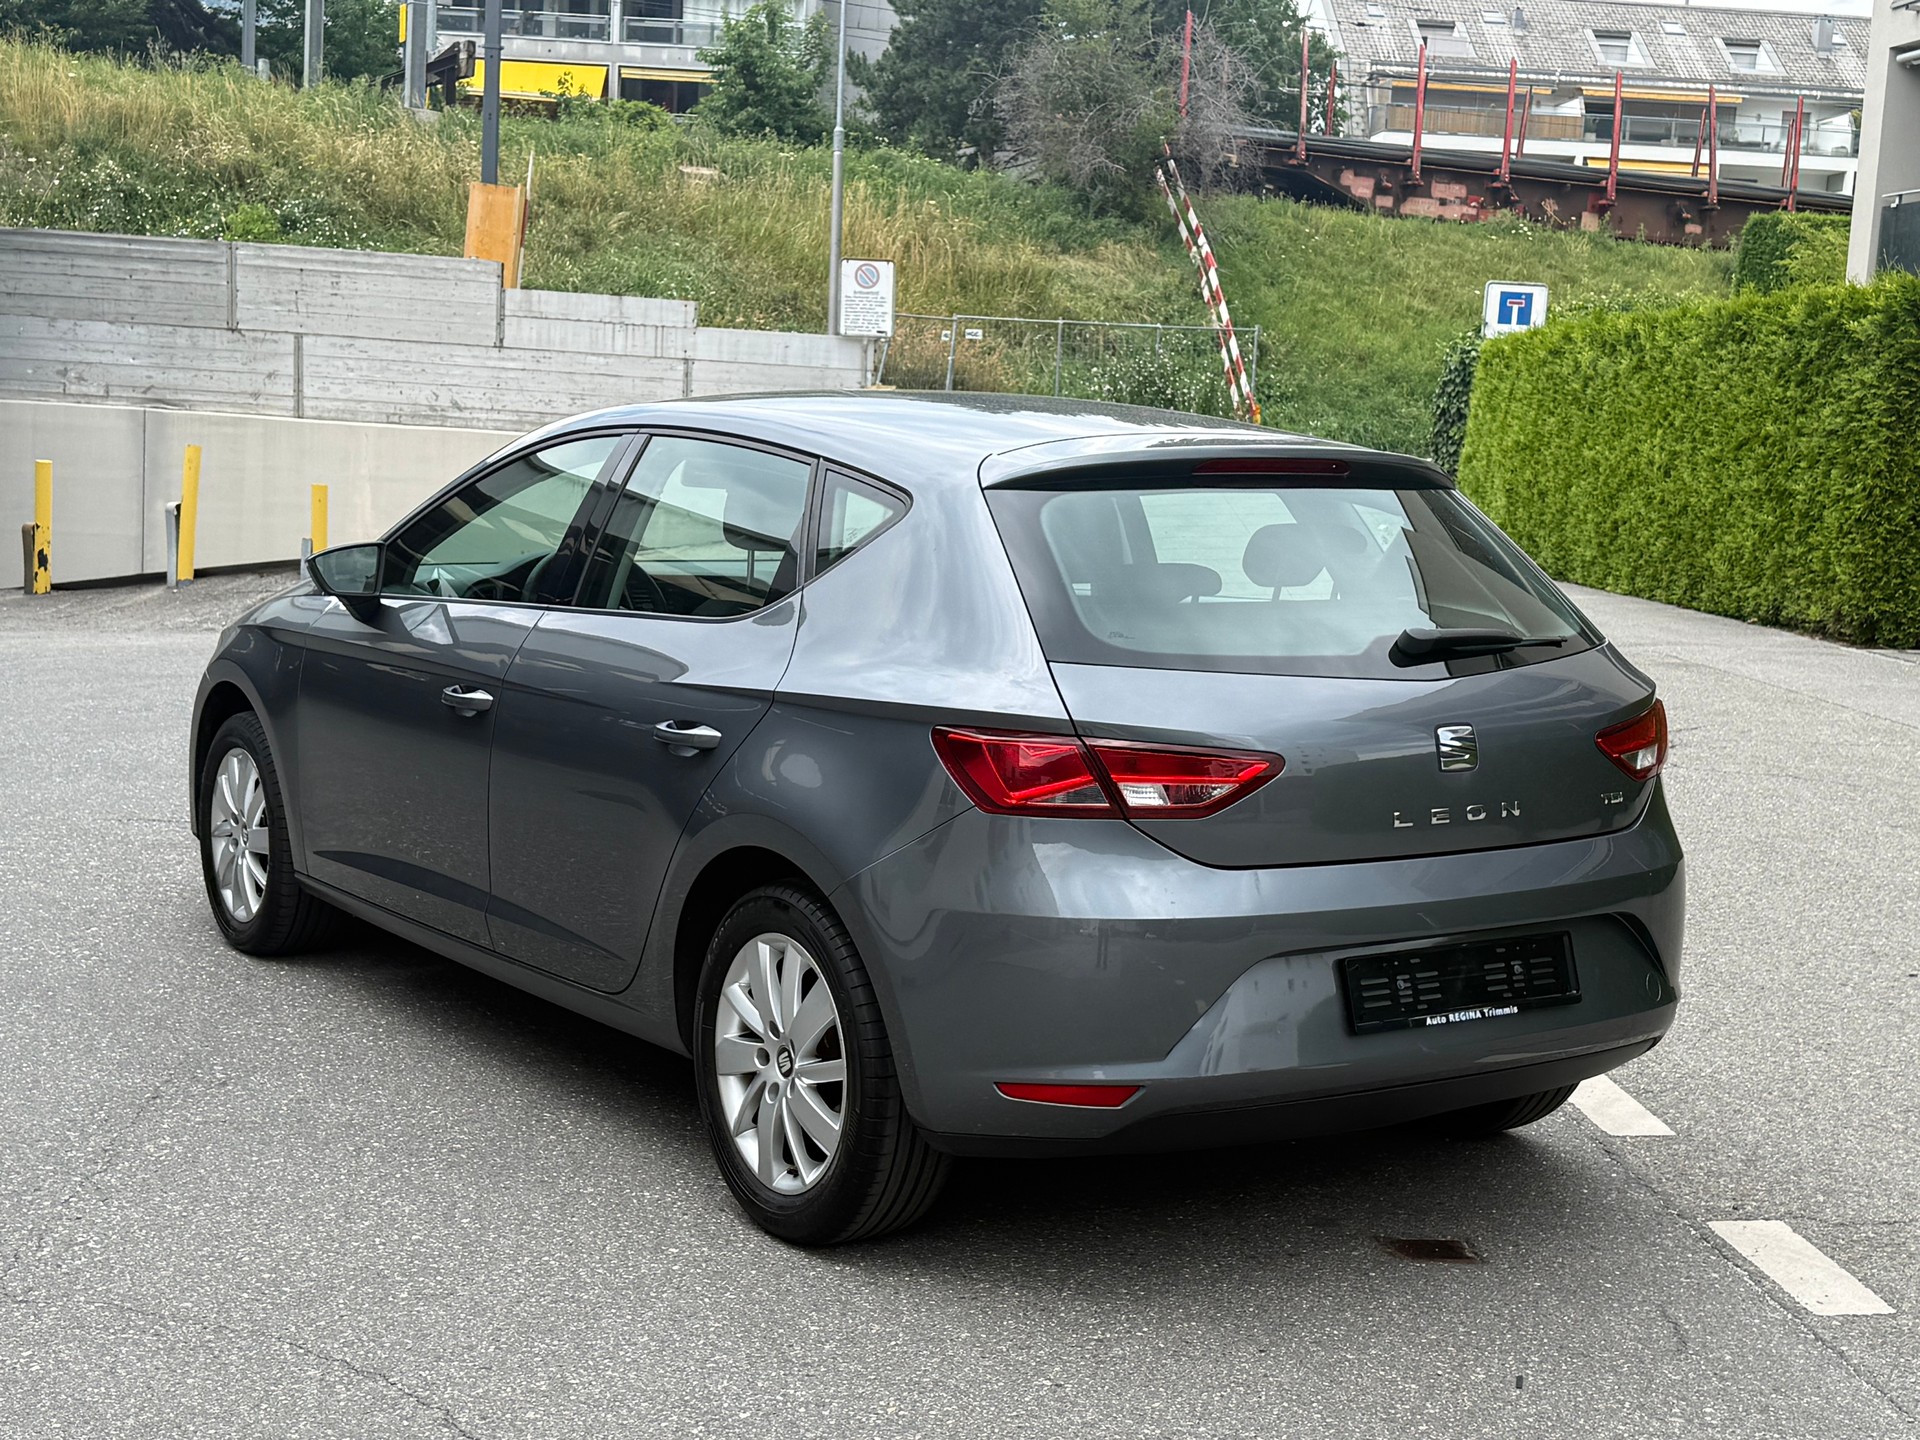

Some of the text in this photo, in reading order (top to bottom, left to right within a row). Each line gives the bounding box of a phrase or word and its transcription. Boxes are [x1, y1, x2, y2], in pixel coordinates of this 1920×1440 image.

[1393, 801, 1520, 828] LEON
[1426, 1005, 1519, 1026] Auto REGINA Trimmis
